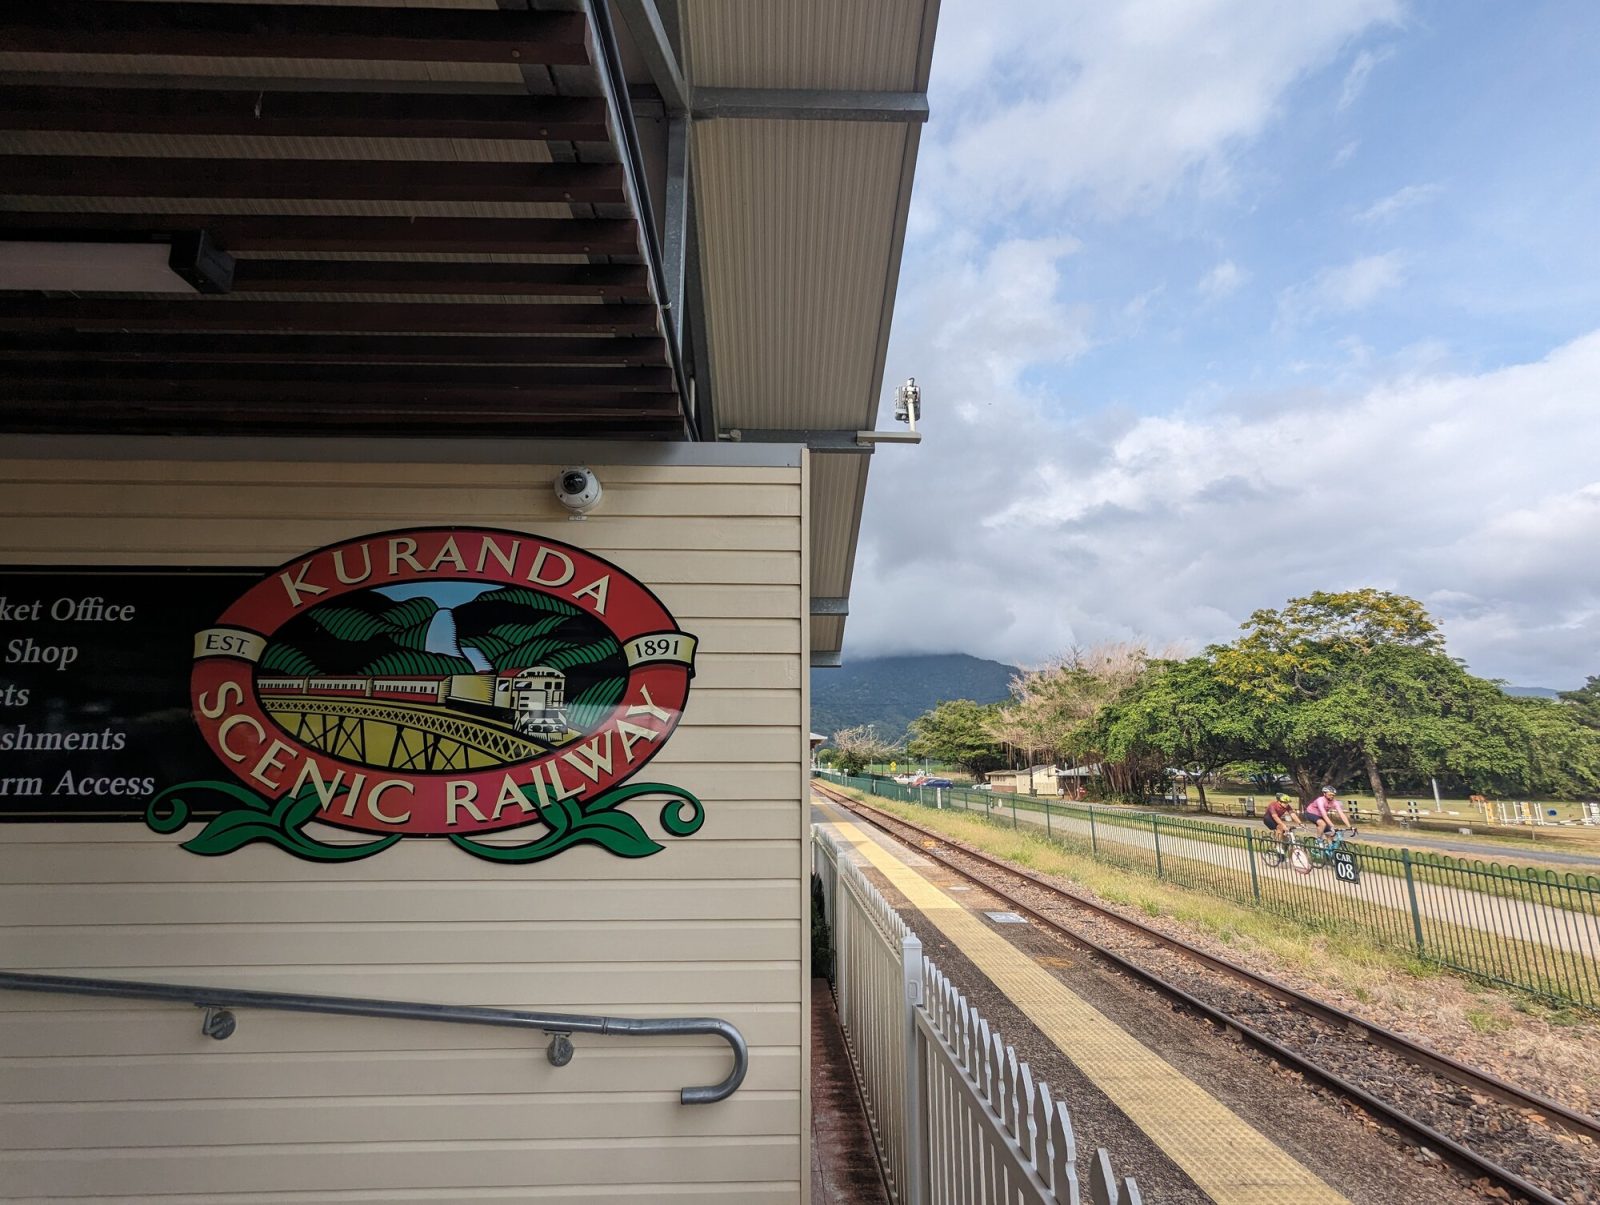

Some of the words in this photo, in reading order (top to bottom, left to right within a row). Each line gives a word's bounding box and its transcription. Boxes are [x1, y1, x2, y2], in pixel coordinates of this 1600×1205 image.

[279, 535, 610, 615] KURANDA
[0, 596, 43, 621] ket
[50, 597, 136, 622] Office
[5, 638, 78, 671] Shop
[205, 634, 250, 655] EST.
[635, 640, 679, 657] 1891
[0, 684, 30, 707] ts
[0, 724, 126, 751] shments
[199, 681, 415, 824] SCENIC
[445, 684, 671, 825] RAILWAY
[0, 777, 42, 796] rm
[51, 769, 155, 796] Access
[1335, 852, 1352, 863] CAR
[1337, 862, 1355, 880] 08
